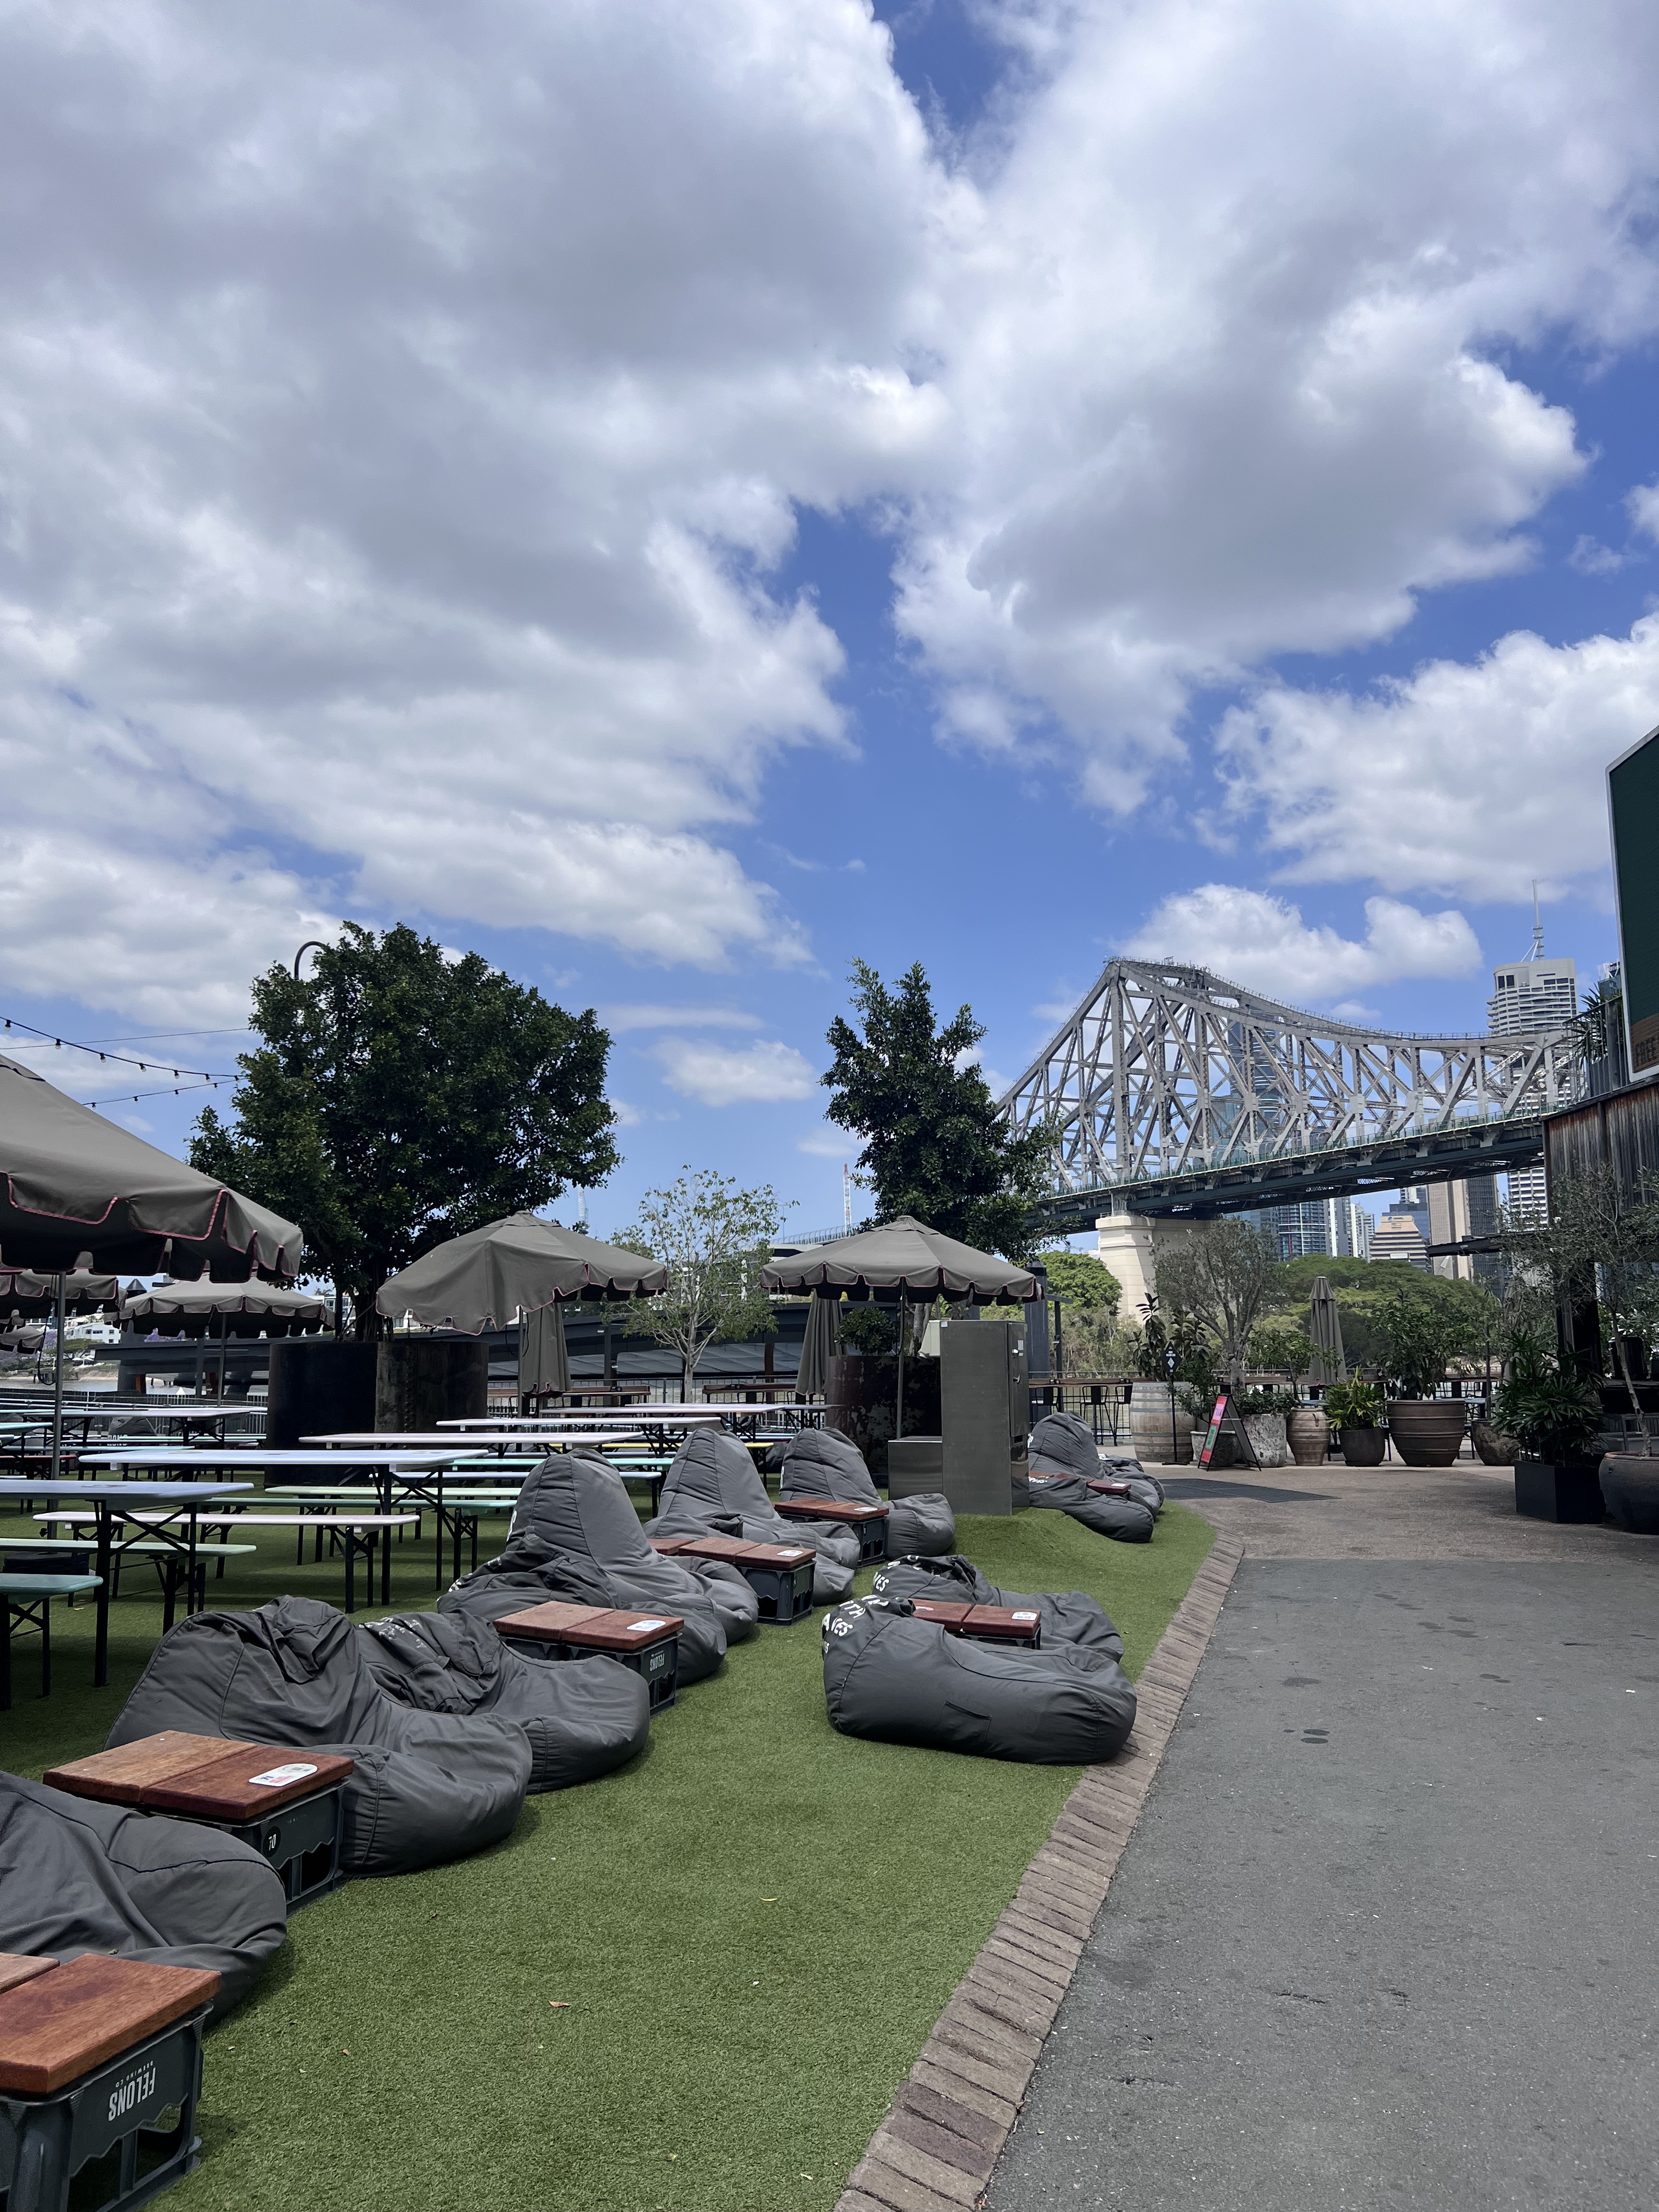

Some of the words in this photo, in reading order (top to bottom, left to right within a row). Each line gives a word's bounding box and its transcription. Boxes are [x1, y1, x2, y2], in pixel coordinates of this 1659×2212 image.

[839, 1600, 866, 1619] ITH
[822, 1613, 854, 1637] AVES
[108, 2067, 156, 2121] FELONS
